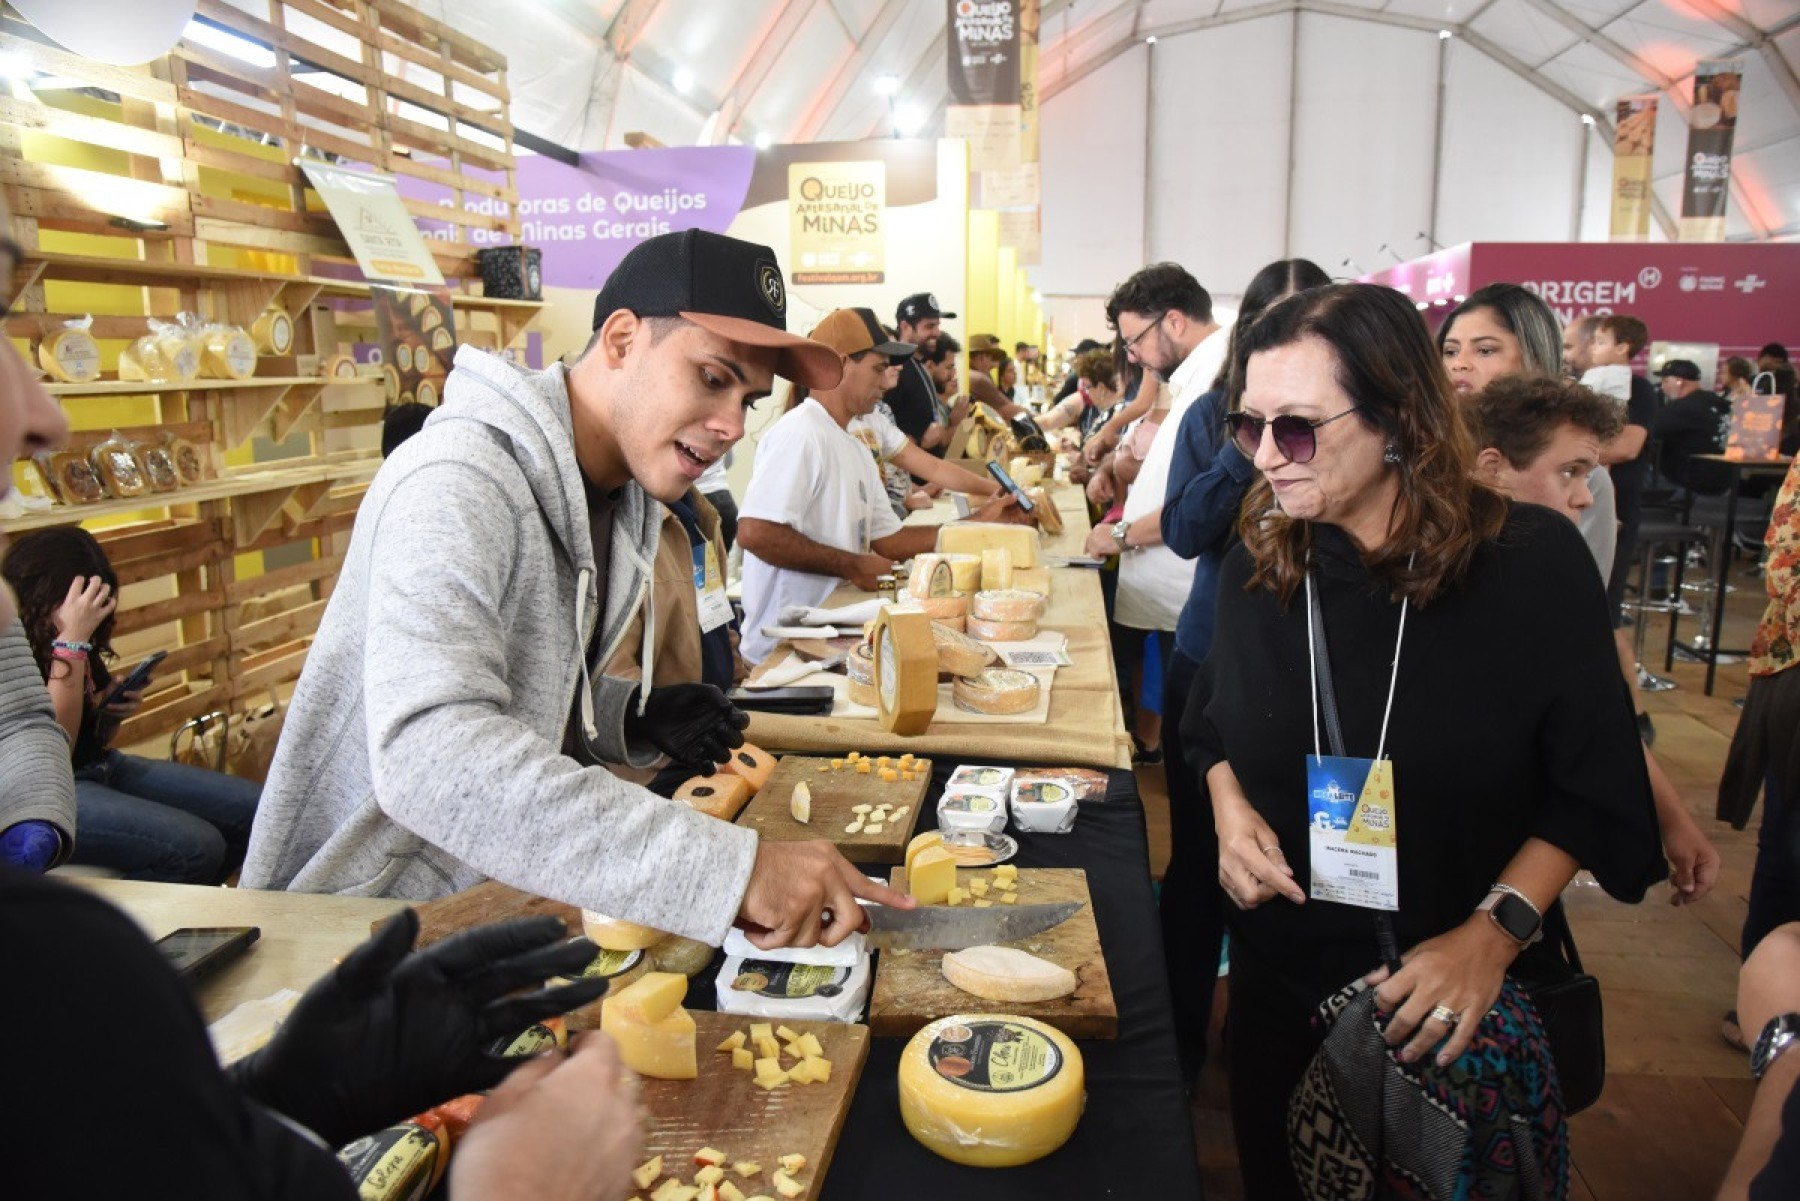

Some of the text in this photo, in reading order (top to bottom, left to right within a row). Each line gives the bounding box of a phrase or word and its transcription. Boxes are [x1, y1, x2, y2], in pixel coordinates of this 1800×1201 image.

[576, 192, 607, 214] de
[613, 188, 708, 214] Queijos
[592, 216, 671, 240] Gerais
